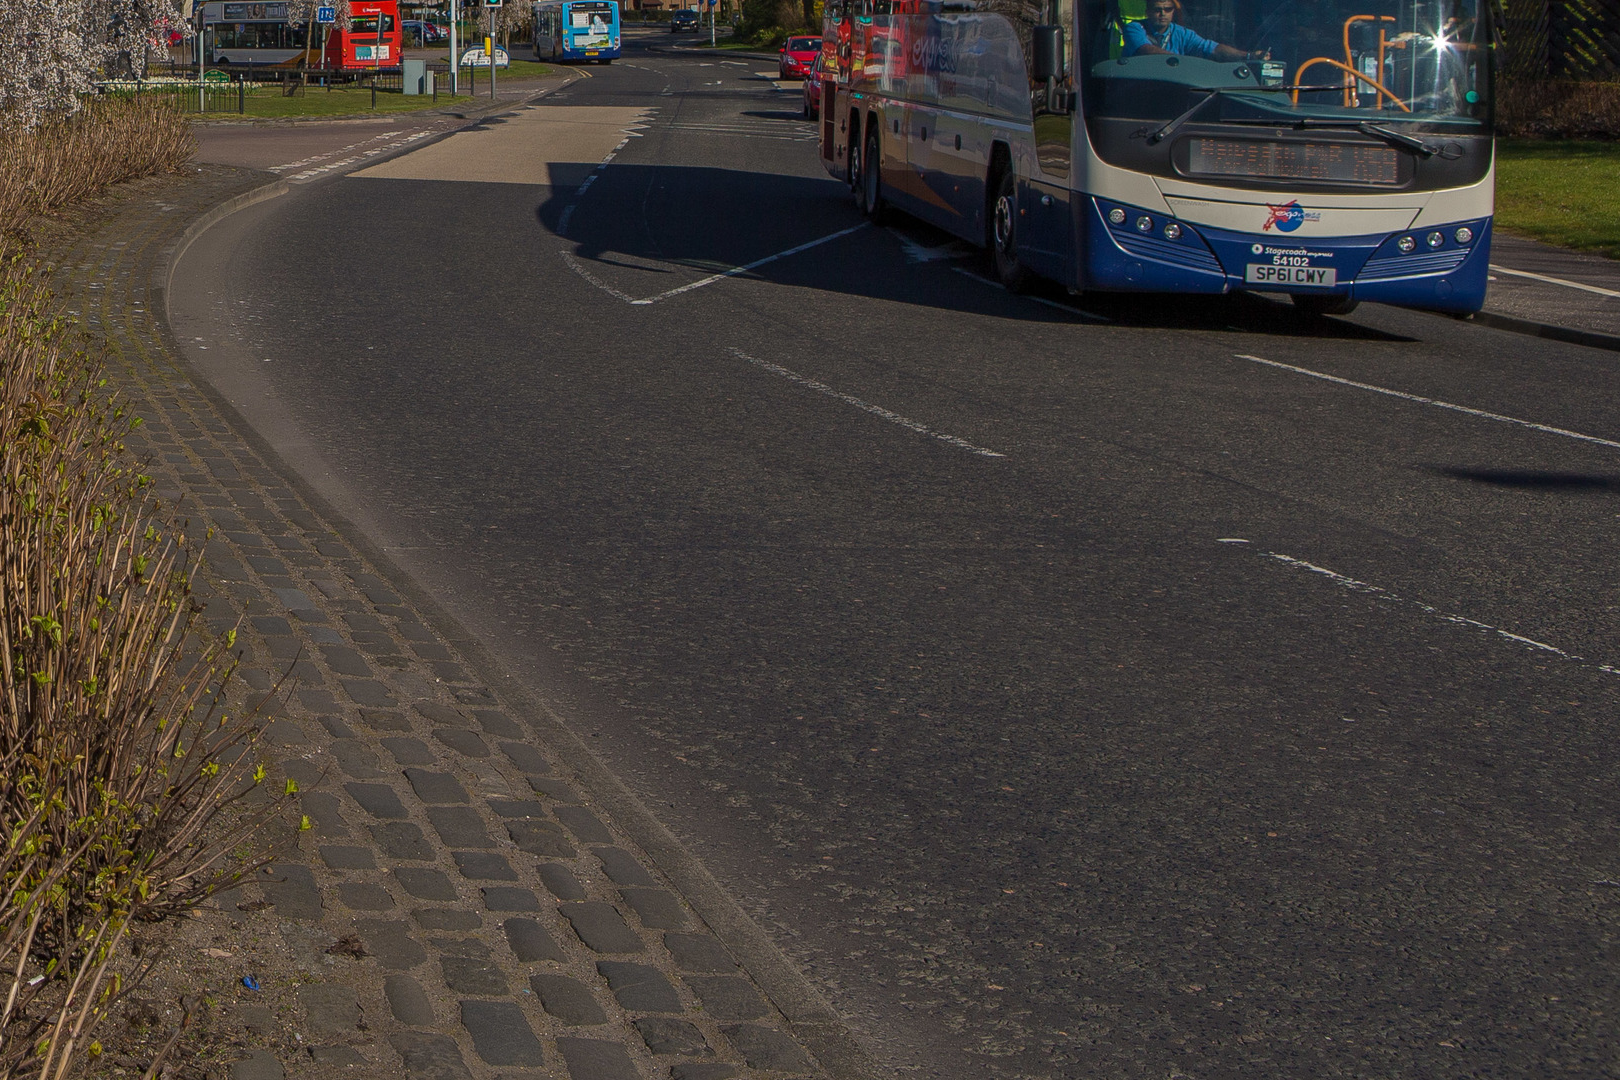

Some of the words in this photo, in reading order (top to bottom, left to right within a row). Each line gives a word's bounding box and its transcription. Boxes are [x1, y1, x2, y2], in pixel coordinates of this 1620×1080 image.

[1264, 246, 1308, 256] Stagecoach
[1273, 255, 1310, 267] 54102
[1256, 267, 1291, 282] SP61
[1295, 268, 1326, 284] CWY
